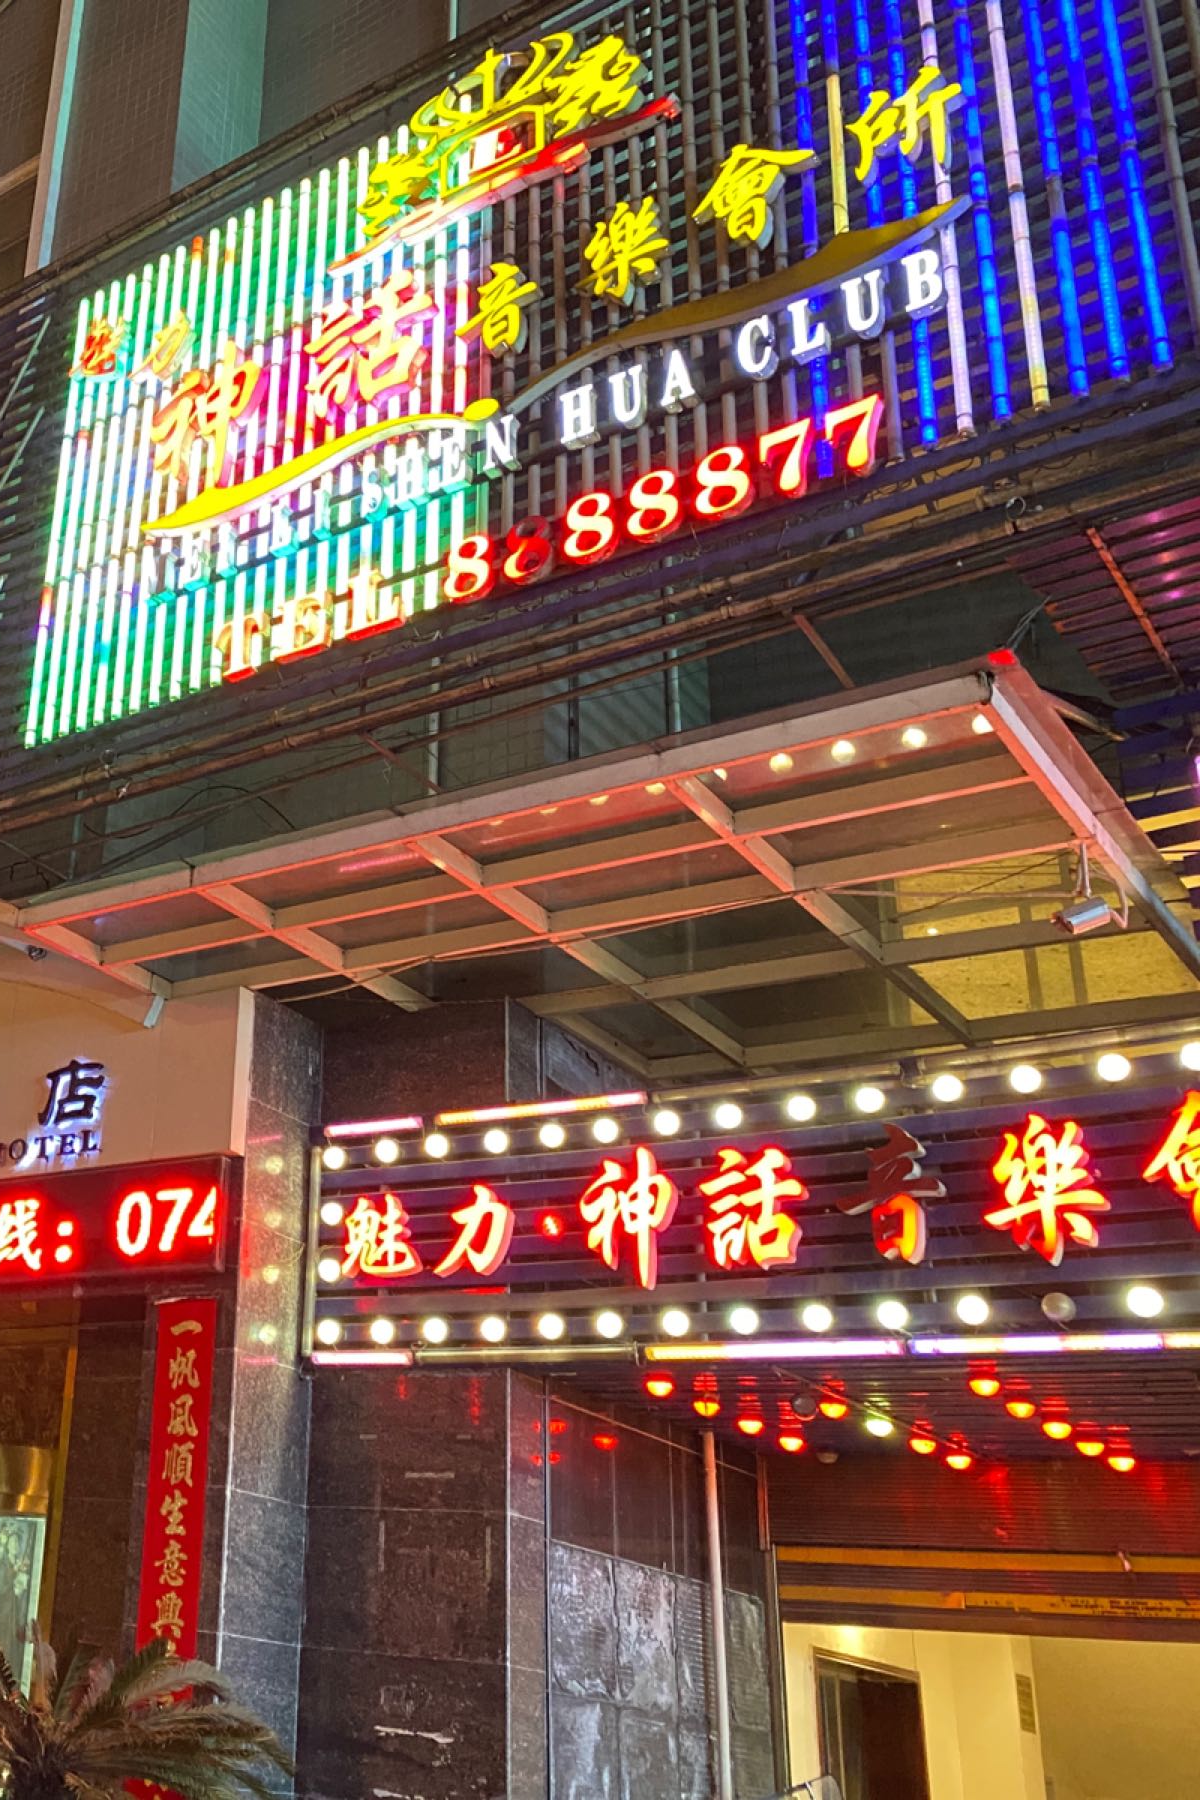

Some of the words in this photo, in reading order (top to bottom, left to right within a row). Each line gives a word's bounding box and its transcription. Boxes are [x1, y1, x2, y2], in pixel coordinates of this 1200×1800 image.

[360, 413, 521, 522] SHEN
[559, 350, 696, 448] HUA
[737, 249, 947, 381] CLUB
[216, 570, 406, 684] TEL
